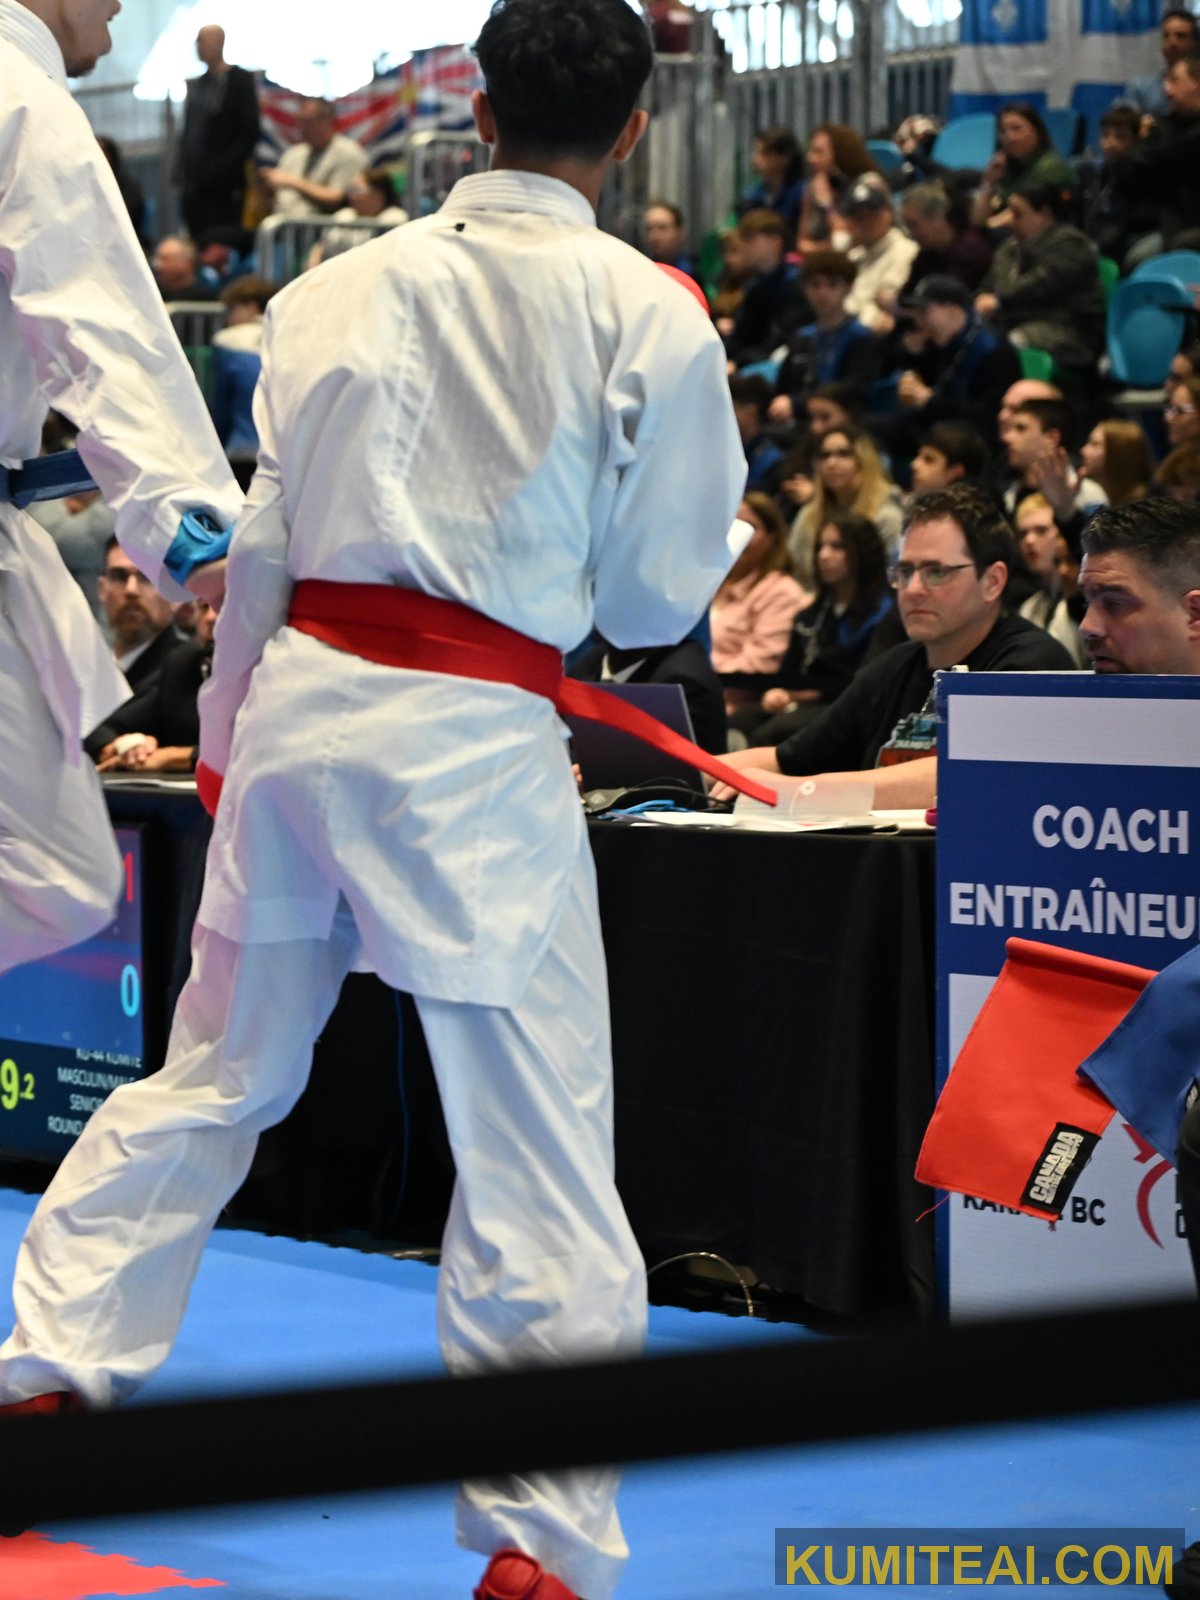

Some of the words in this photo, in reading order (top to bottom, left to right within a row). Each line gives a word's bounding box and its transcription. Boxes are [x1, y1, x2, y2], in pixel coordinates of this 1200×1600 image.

[1033, 804, 1189, 854] COACH
[950, 877, 1200, 940] ENTRAÎNEU
[121, 964, 140, 1017] 0
[1029, 1131, 1083, 1202] CANADA
[1072, 1196, 1106, 1226] BC
